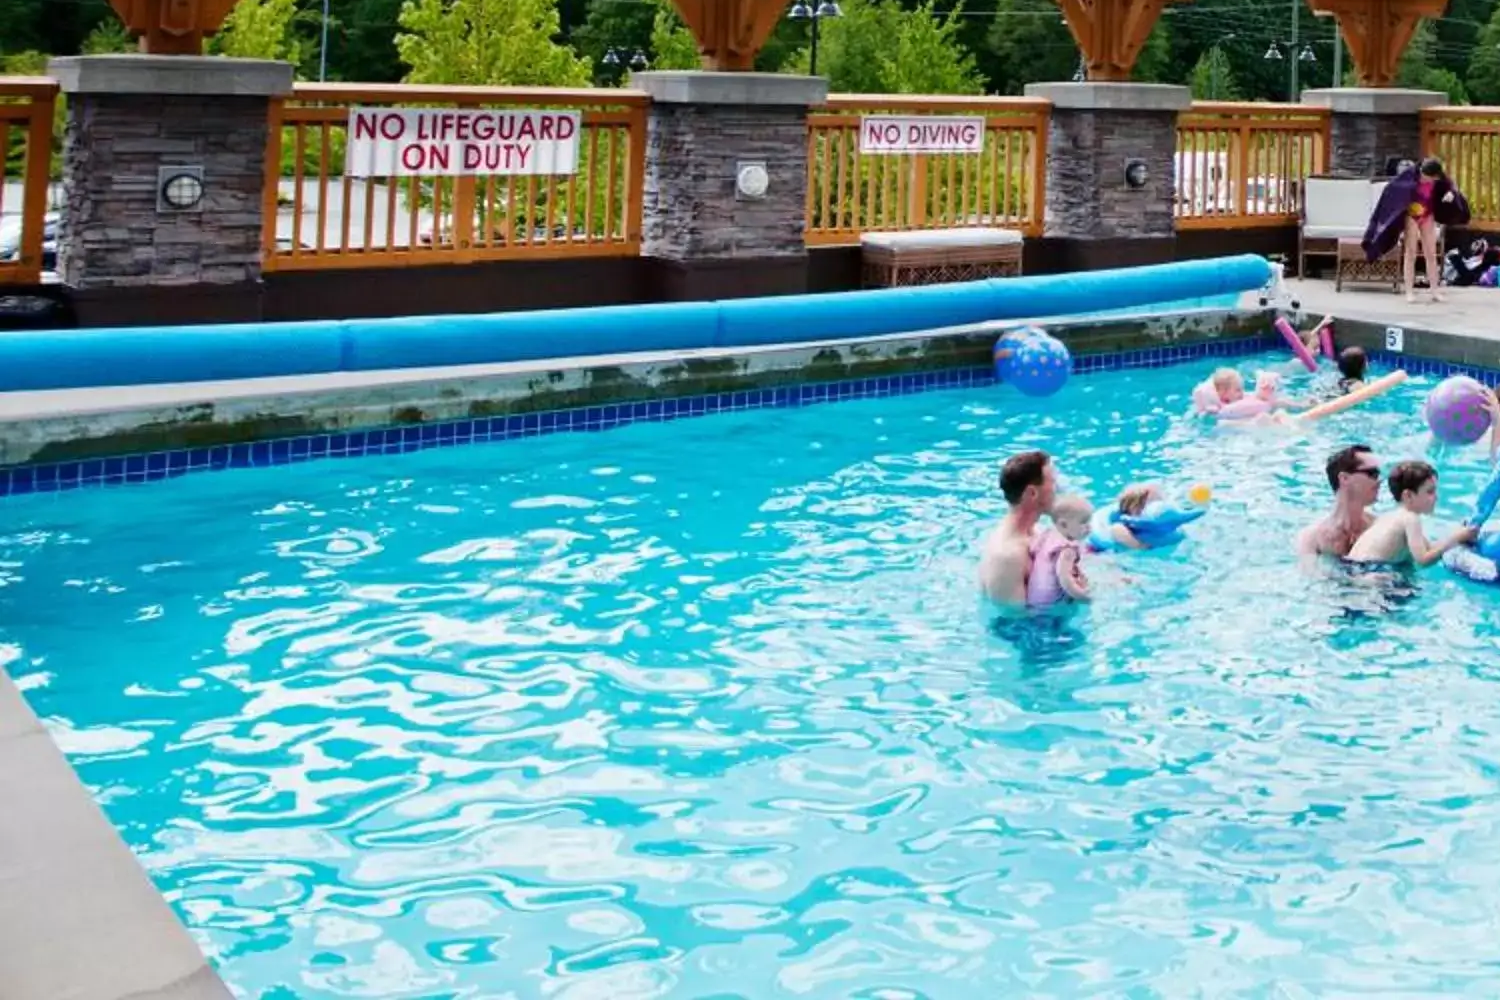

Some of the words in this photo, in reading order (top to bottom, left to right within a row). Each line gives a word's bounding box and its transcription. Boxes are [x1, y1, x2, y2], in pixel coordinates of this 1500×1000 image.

[355, 113, 406, 140] NO
[416, 113, 575, 141] LIFEGUARD
[868, 124, 901, 145] NO
[907, 124, 977, 145] DIVING
[402, 143, 450, 170] ON
[463, 144, 532, 170] DUTY
